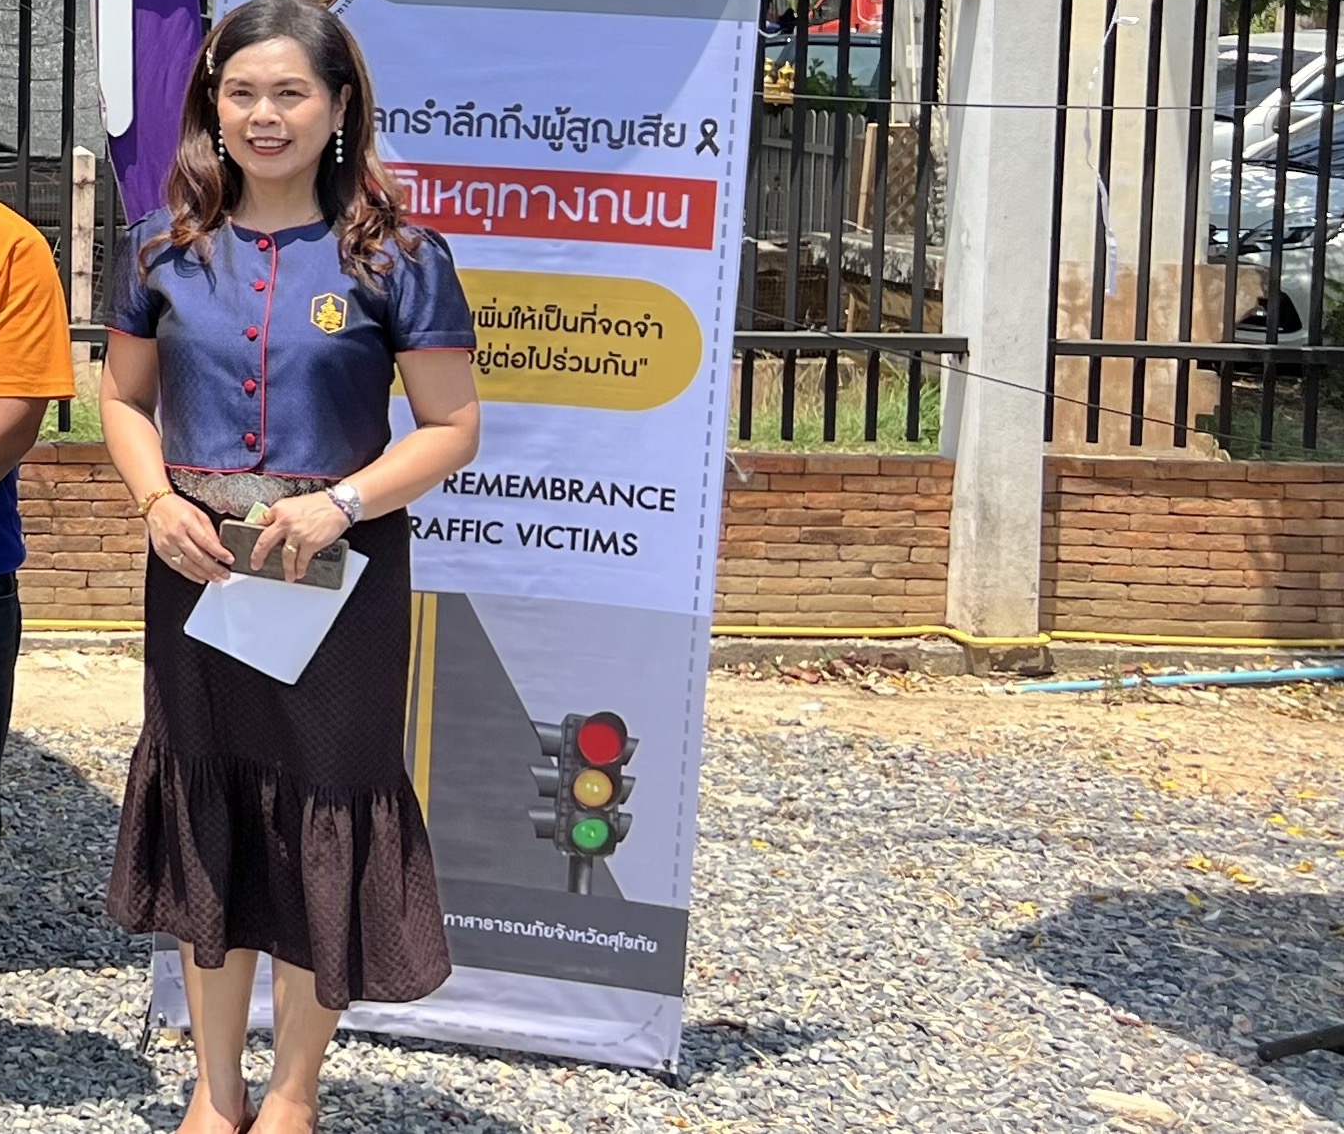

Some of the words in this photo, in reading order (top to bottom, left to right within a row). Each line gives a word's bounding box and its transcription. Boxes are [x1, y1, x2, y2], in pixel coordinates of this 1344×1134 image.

[442, 471, 676, 513] REMEMBRANCE
[408, 515, 505, 545] RAFFIC
[516, 522, 639, 557] VICTIMS
[443, 912, 658, 954] ทาสาธารณภัยจังหวัดสุโขทัย
